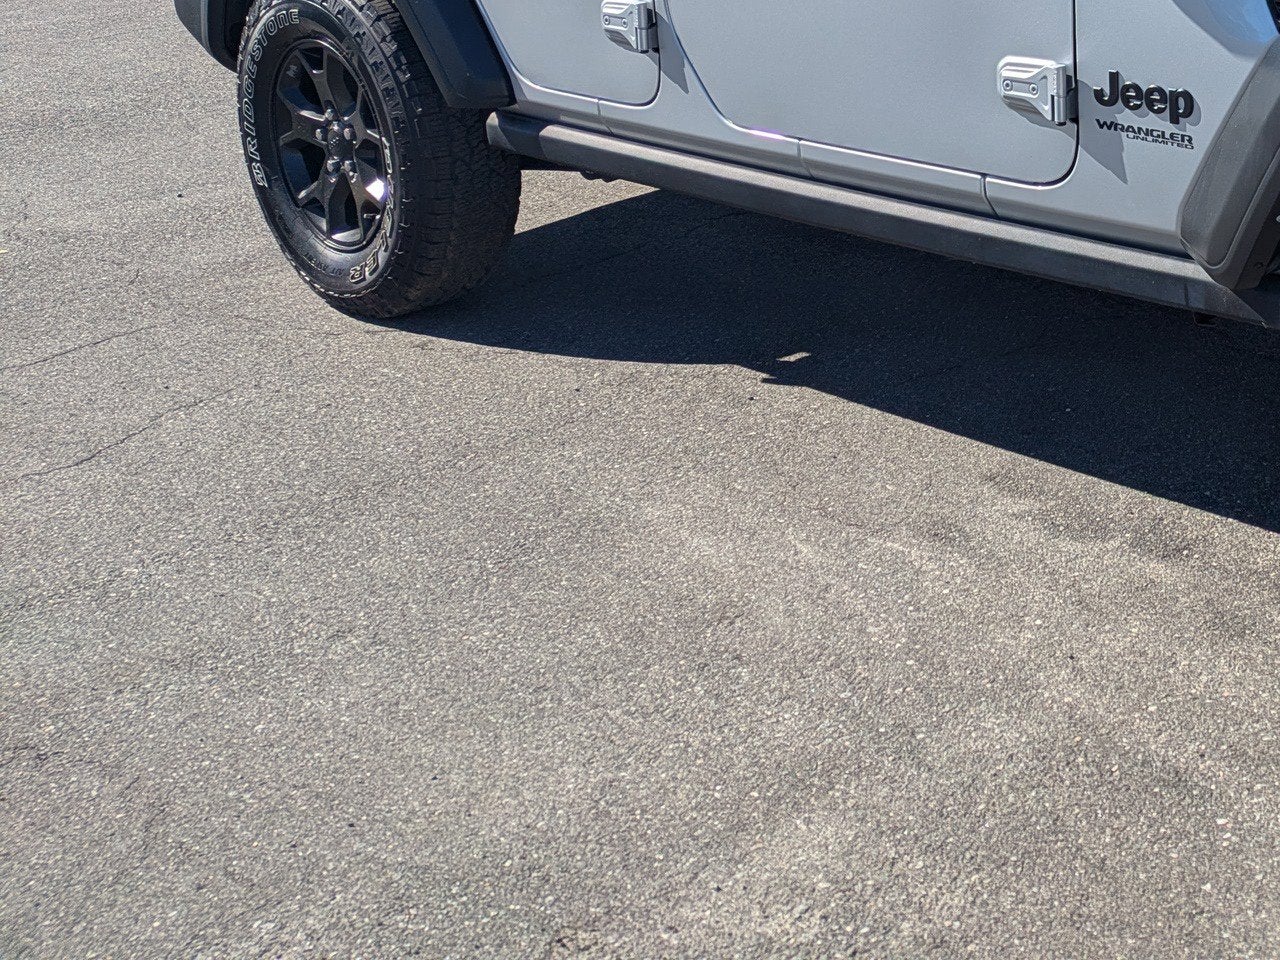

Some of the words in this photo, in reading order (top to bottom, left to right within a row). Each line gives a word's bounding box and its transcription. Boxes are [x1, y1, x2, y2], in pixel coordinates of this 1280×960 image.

[242, 8, 300, 188] BRIDGESTONE
[1092, 69, 1195, 125] Jeep
[1095, 118, 1194, 145] WRANGLER
[1125, 133, 1195, 150] UNLIMITED
